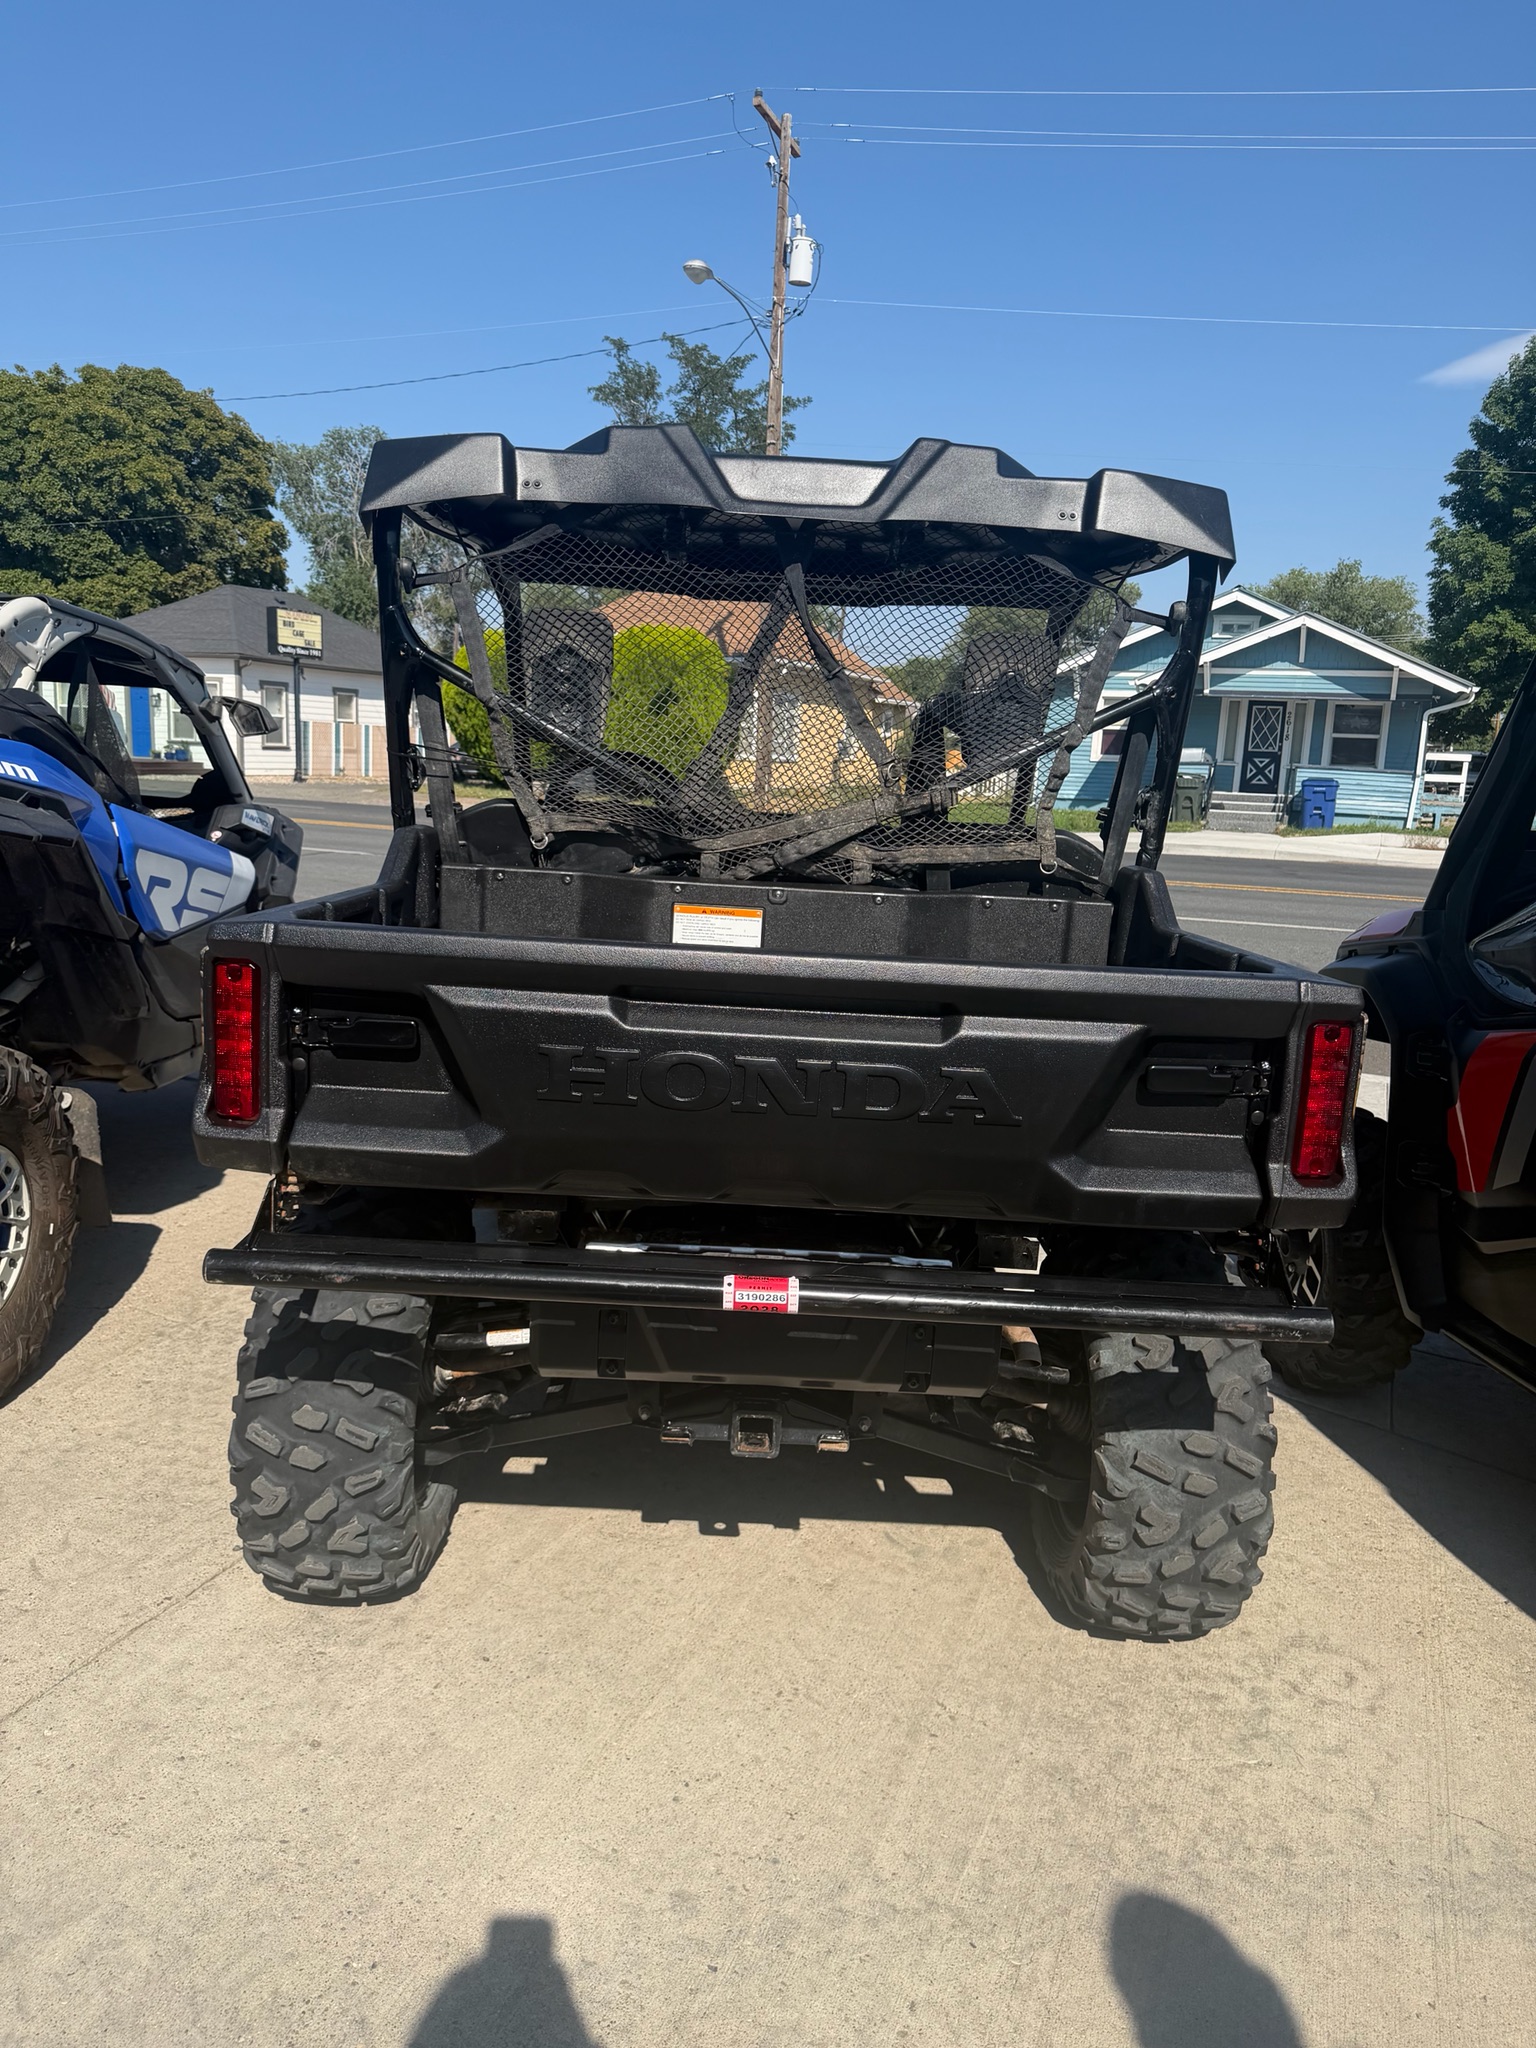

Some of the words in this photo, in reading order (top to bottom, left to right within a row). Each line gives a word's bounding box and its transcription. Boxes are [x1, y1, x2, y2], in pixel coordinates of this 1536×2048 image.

[278, 646, 296, 654] Quality
[135, 848, 232, 932] RS
[537, 1043, 1023, 1127] HONDA
[737, 1292, 786, 1302] 3190286
